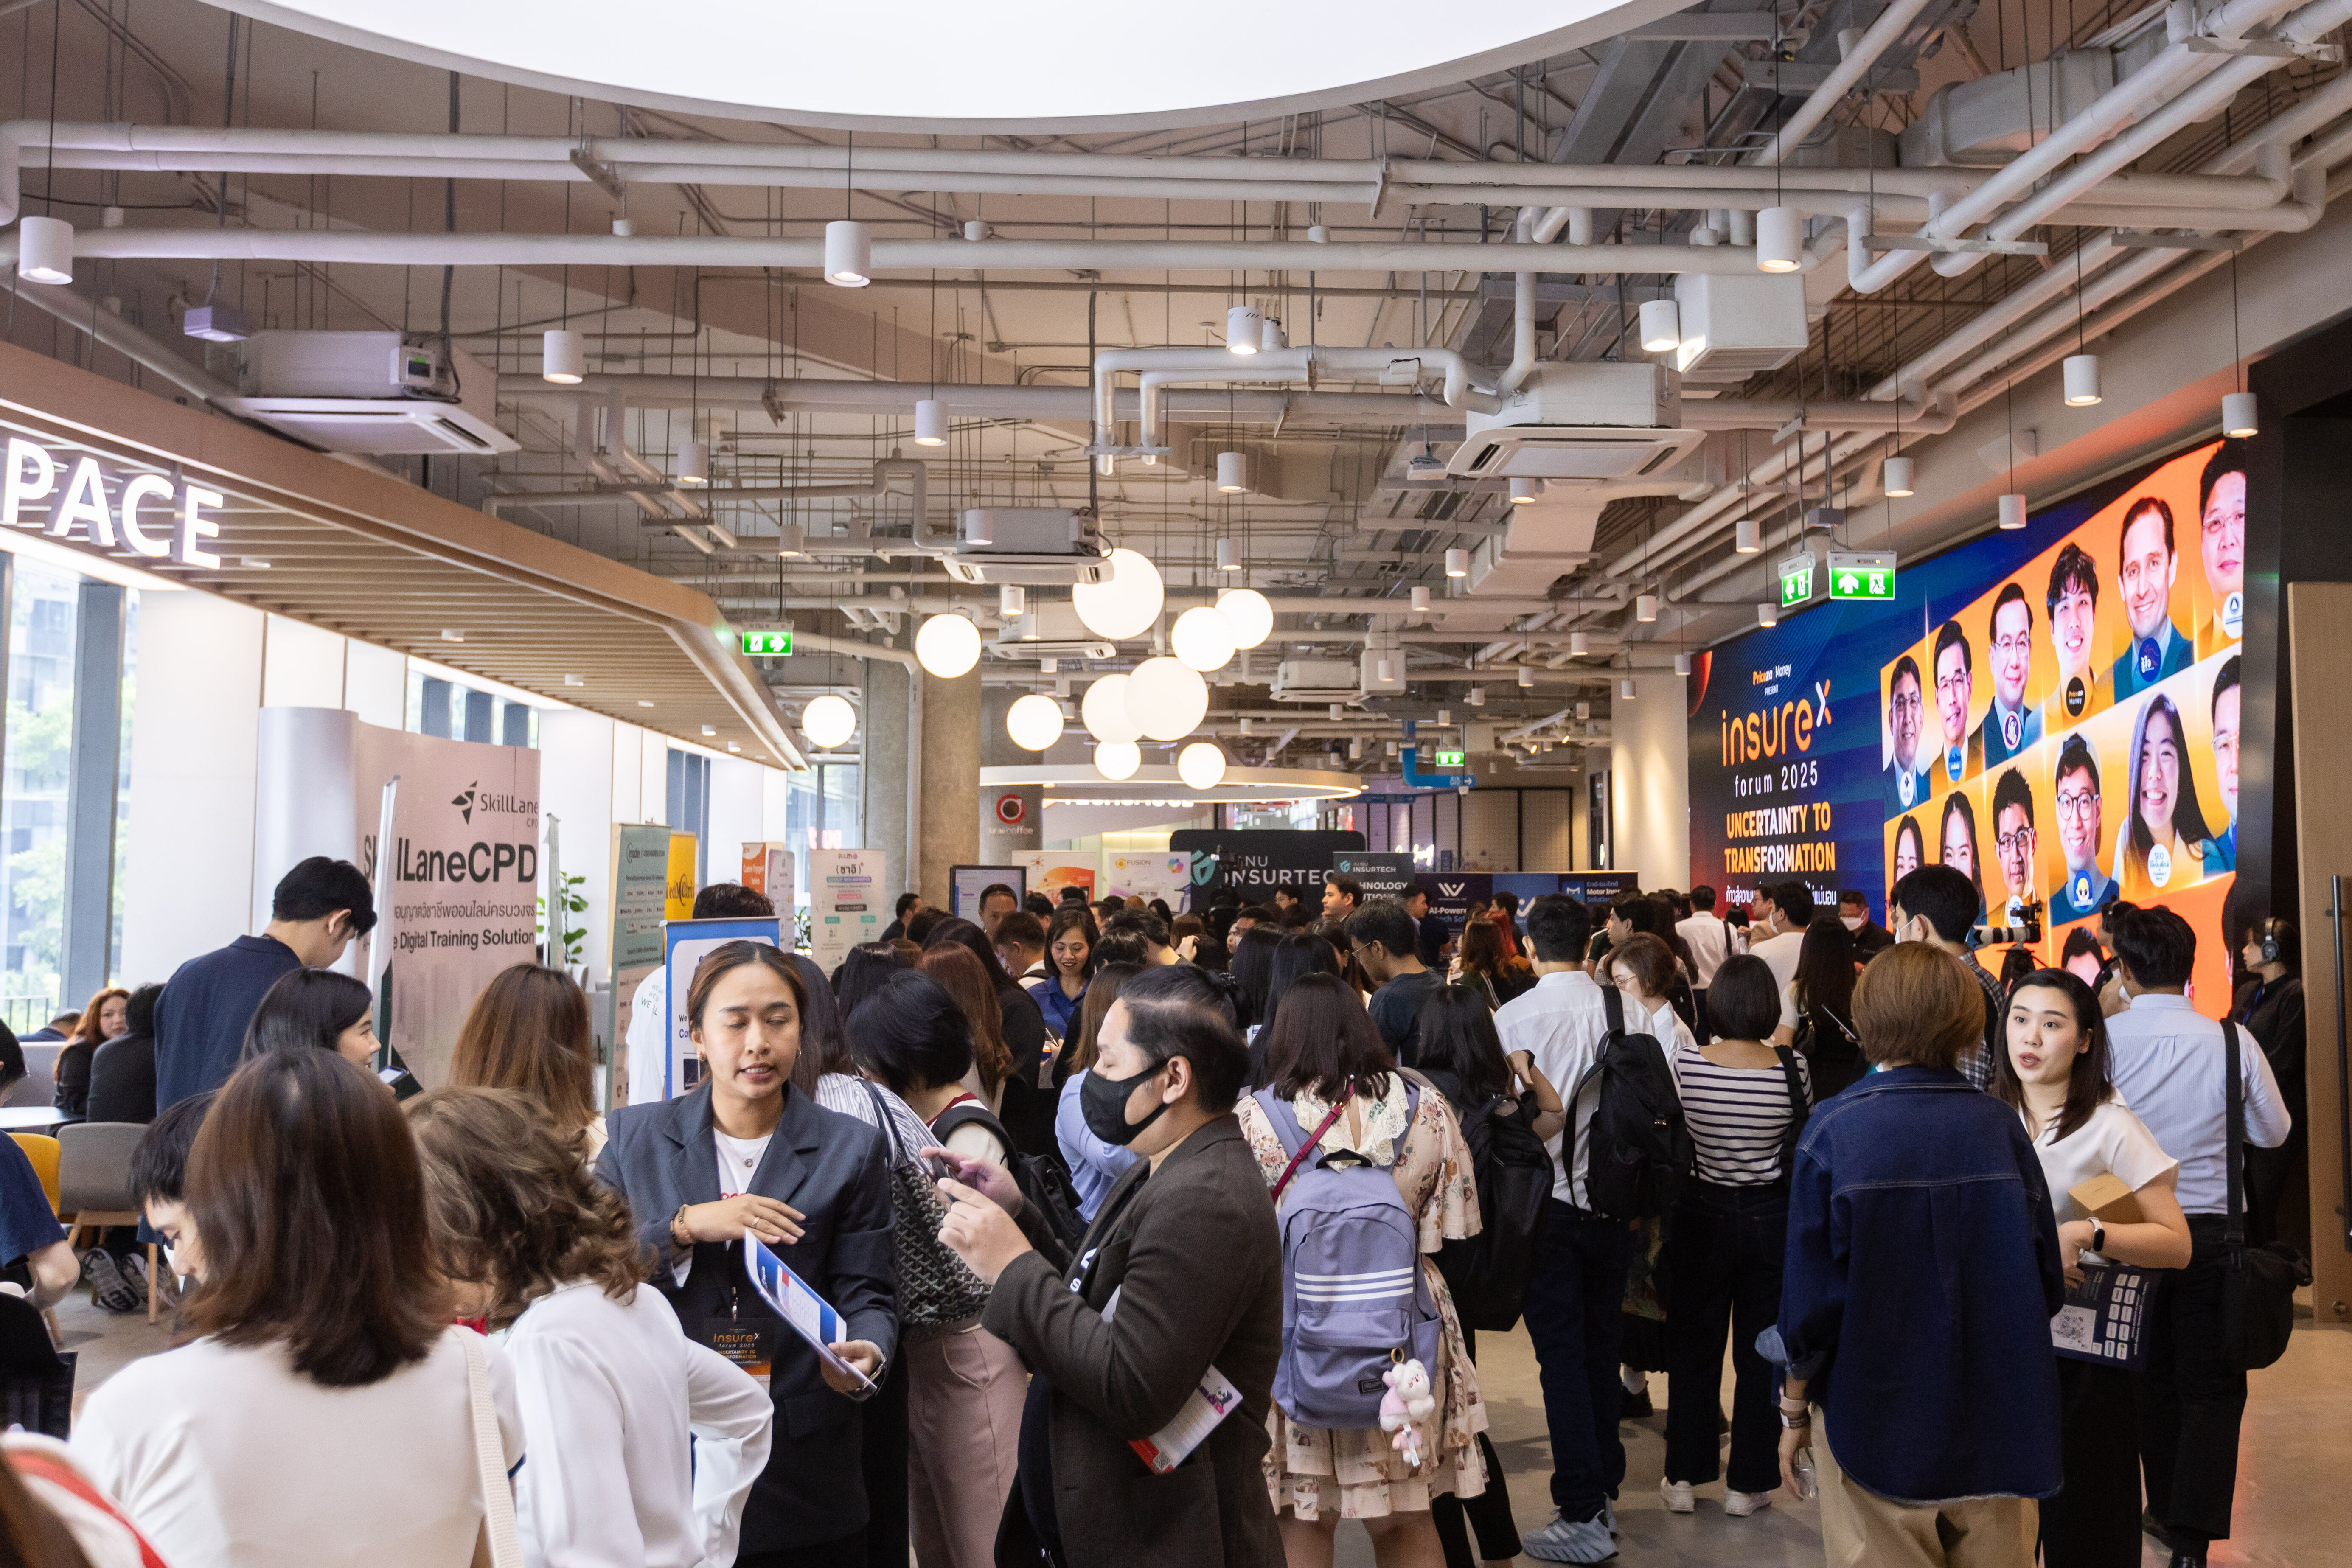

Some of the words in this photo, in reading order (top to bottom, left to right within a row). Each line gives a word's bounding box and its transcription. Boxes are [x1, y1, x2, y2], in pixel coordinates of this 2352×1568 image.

[3, 437, 223, 570] PACE
[1775, 664, 1791, 678] Money
[1765, 684, 1779, 696] PRESENT
[1735, 774, 1772, 797] forum
[1781, 760, 1818, 791] 2025
[480, 793, 538, 814] SkillLane
[1726, 804, 1807, 839] UNCERTAINTY
[1813, 801, 1831, 832] TO
[808, 826, 842, 850] tue
[1724, 842, 1836, 874] TRANSFORMATION
[1224, 870, 1335, 885] INSURTEC
[400, 931, 428, 953] Digital
[430, 929, 479, 950] Training
[483, 928, 535, 945] Solution
[679, 1014, 688, 1022] We
